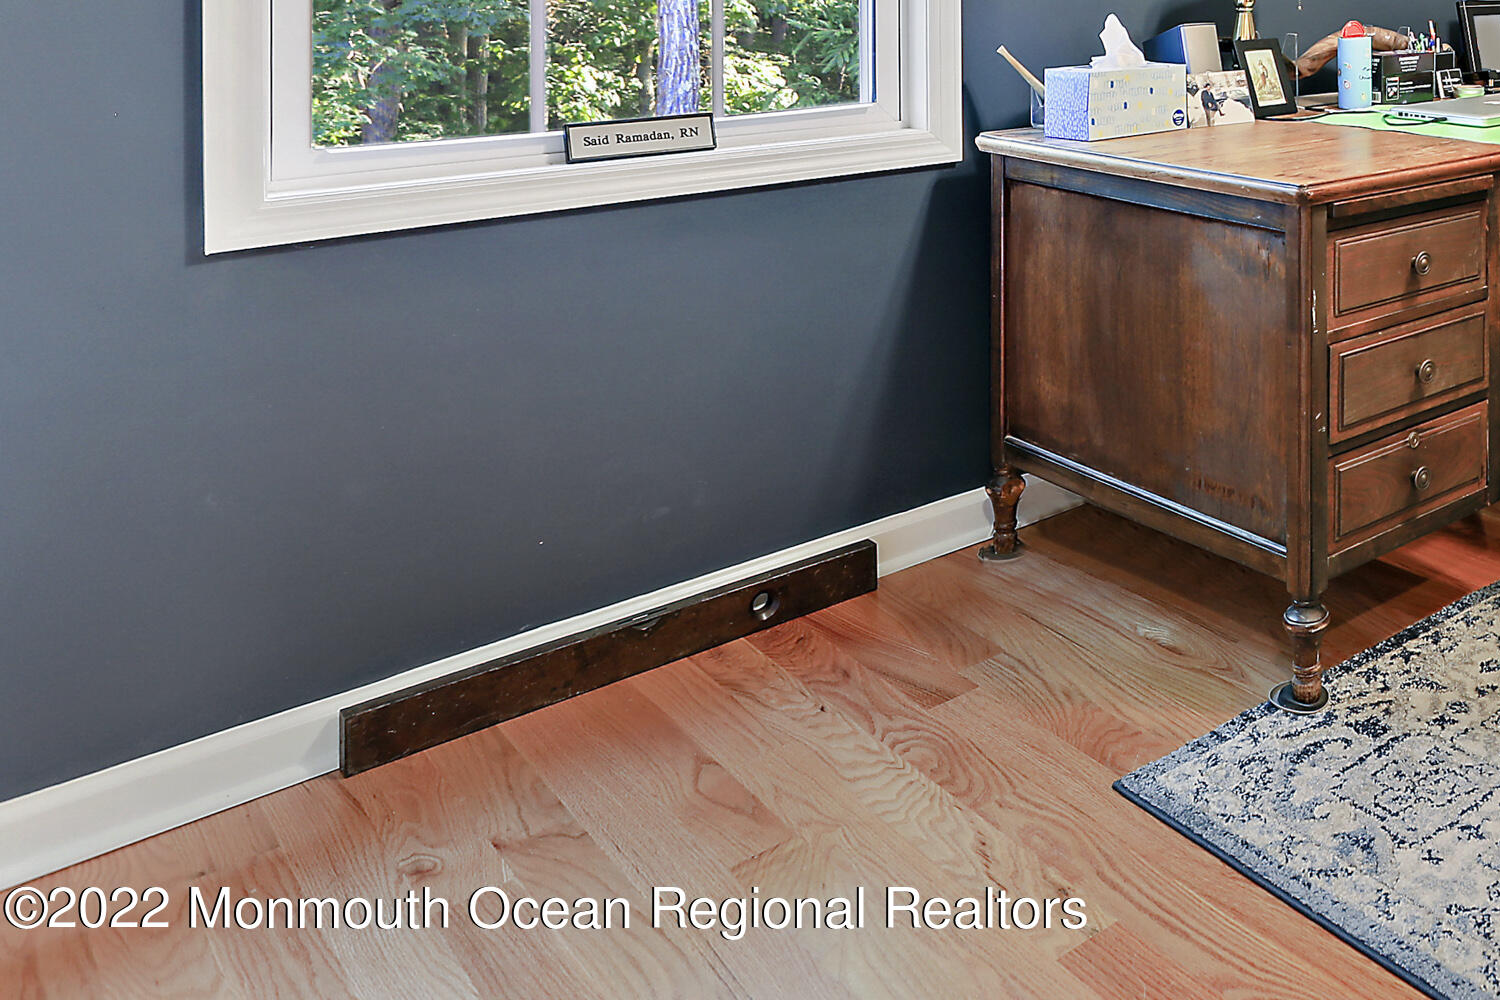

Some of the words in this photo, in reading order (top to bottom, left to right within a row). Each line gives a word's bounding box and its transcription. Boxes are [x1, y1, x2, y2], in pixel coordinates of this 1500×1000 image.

[583, 135, 610, 147] Said
[616, 130, 675, 145] Ramadan,
[680, 127, 700, 138] RN
